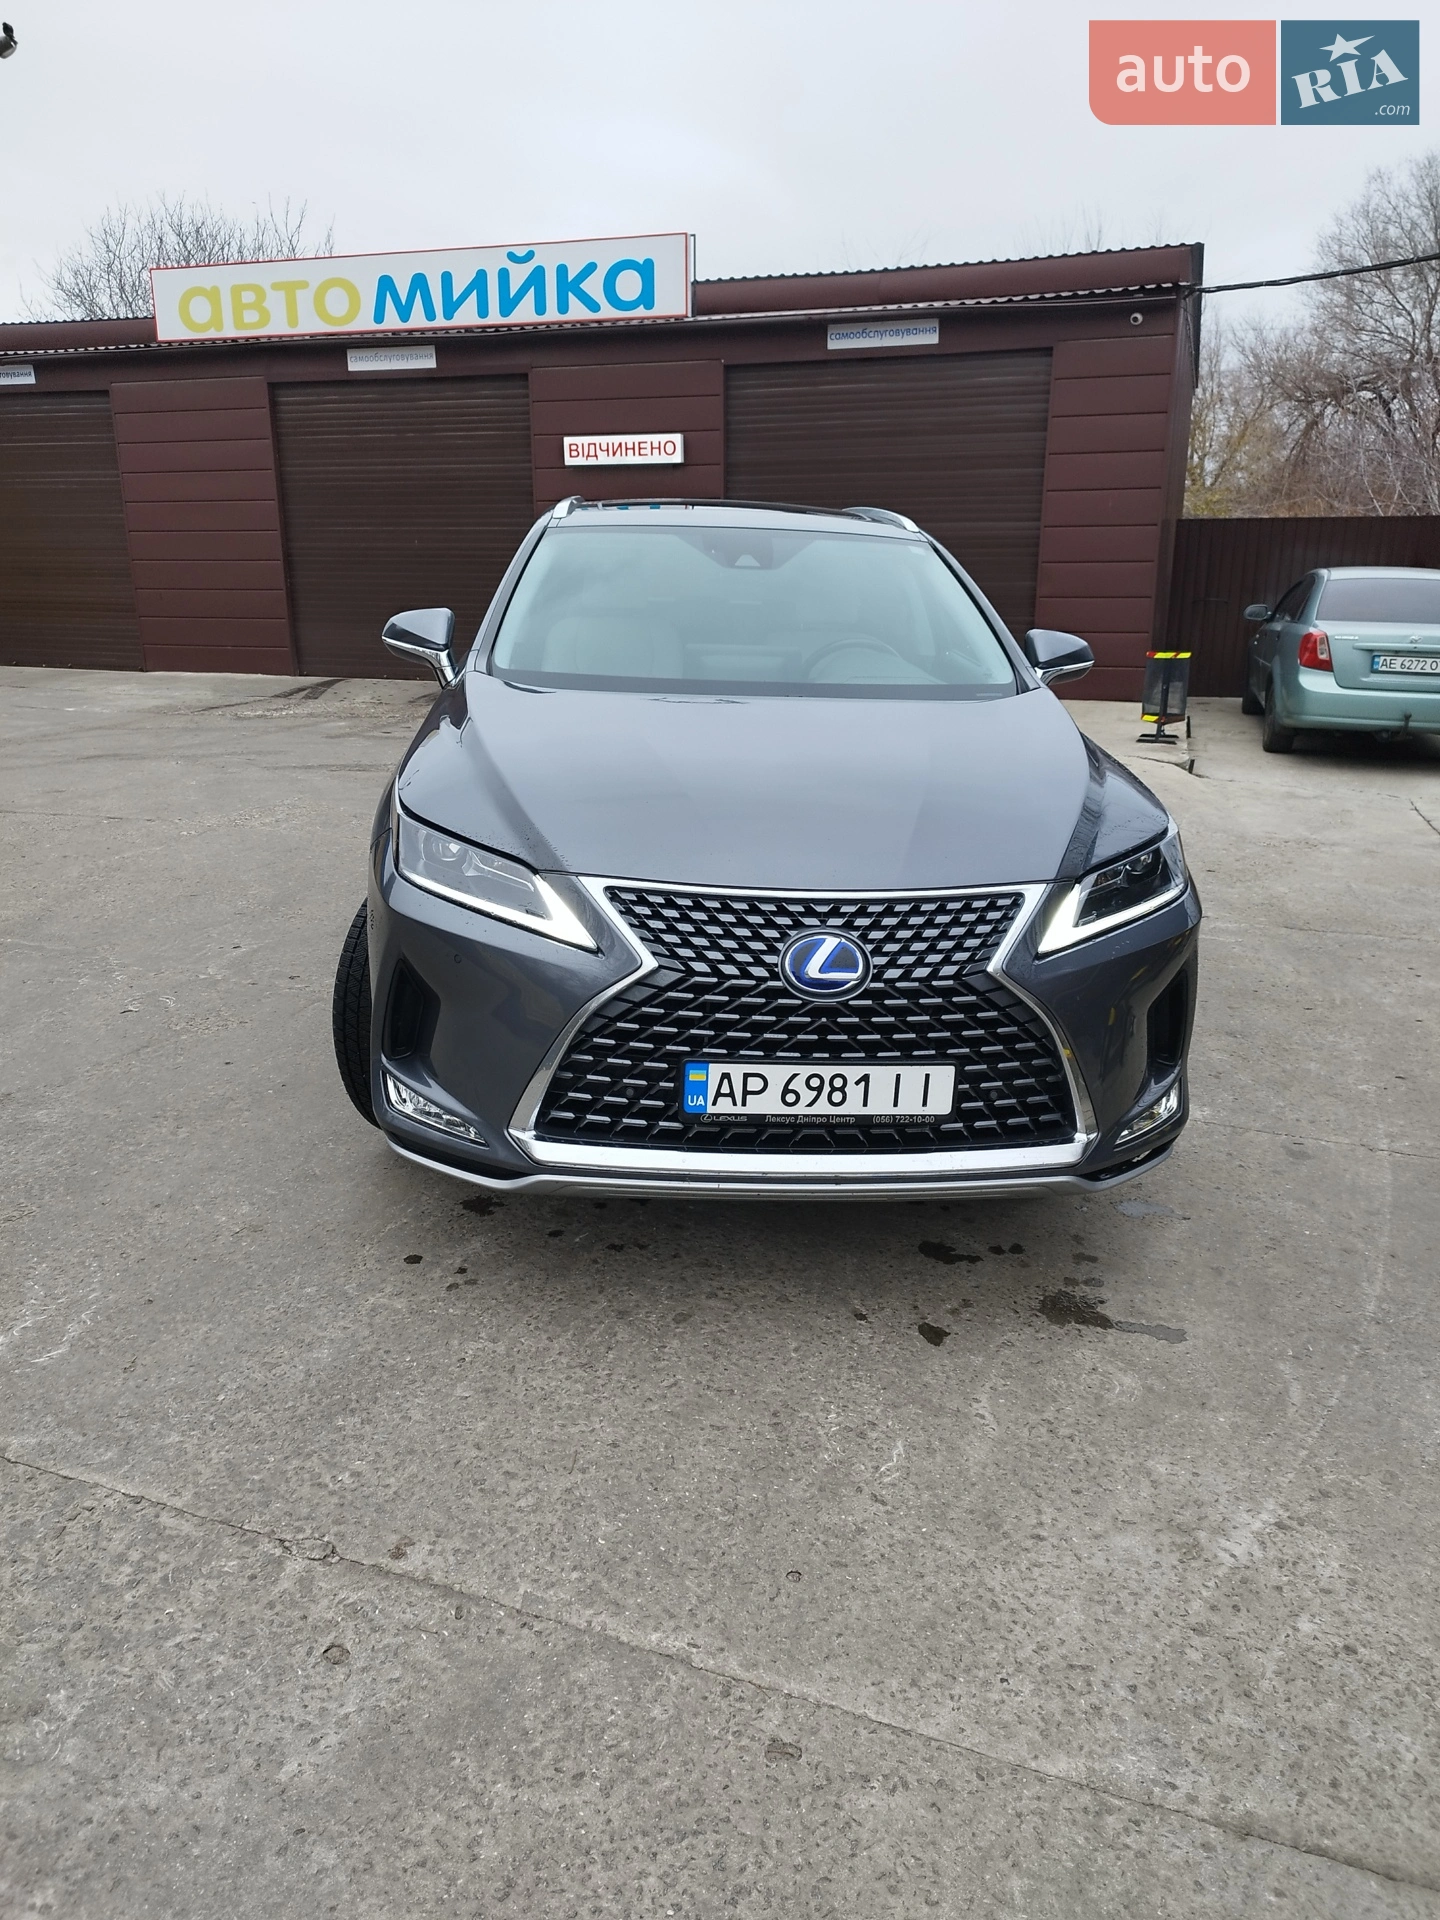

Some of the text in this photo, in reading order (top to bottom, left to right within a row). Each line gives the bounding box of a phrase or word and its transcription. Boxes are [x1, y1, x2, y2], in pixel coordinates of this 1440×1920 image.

[829, 325, 937, 341] самообслуговування
[349, 351, 434, 364] самообслуговування
[568, 440, 677, 461] ВІДЧИНЕНО
[1380, 658, 1397, 669] AE
[1400, 659, 1428, 671] 6272
[711, 1072, 769, 1107] AP
[780, 1072, 870, 1108] 6981
[687, 1094, 705, 1107] UA
[765, 1115, 856, 1124] Лексус Дніпро Центр
[872, 1115, 935, 1124] (056) 722-10-00
